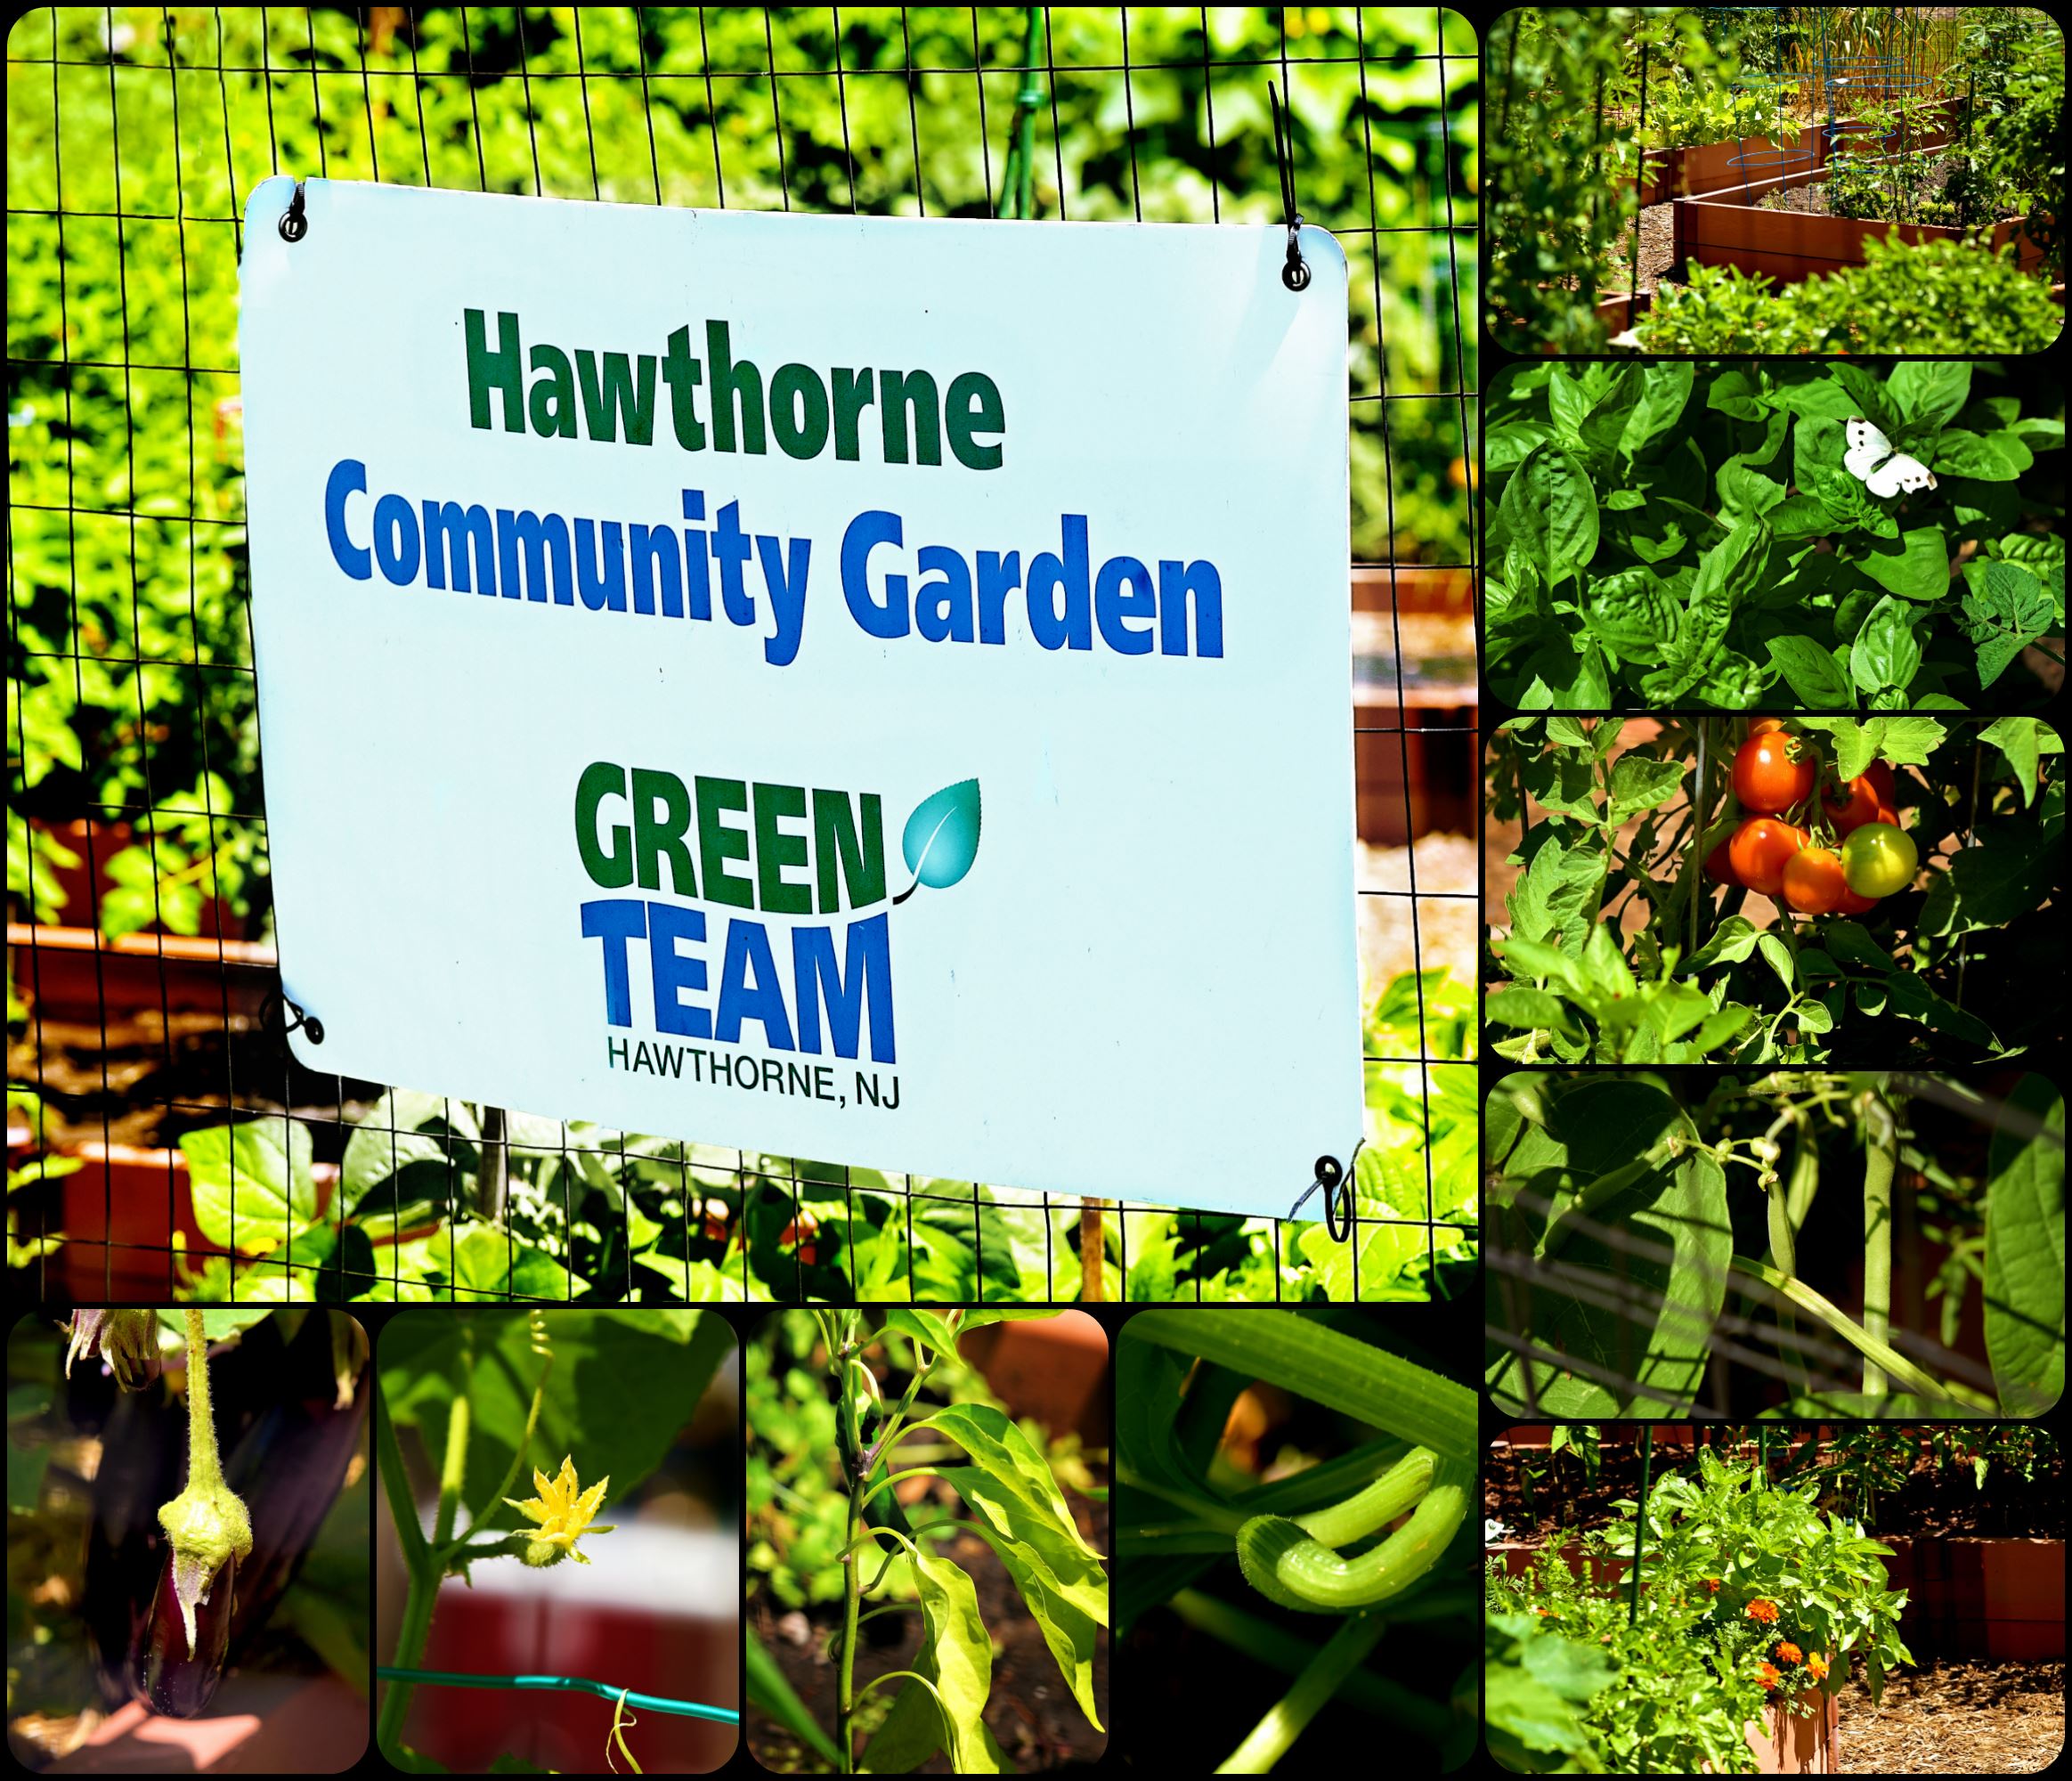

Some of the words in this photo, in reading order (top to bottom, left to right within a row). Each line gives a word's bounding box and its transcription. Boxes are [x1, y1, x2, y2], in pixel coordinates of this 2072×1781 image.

[463, 307, 1006, 471] Hawthorne
[324, 459, 812, 667] Community
[840, 509, 1224, 659] Garden
[574, 760, 887, 915] GREEN
[580, 899, 897, 1065] TEAM
[607, 1036, 847, 1110] HAWTHORNE,
[855, 1070, 900, 1110] NJ
